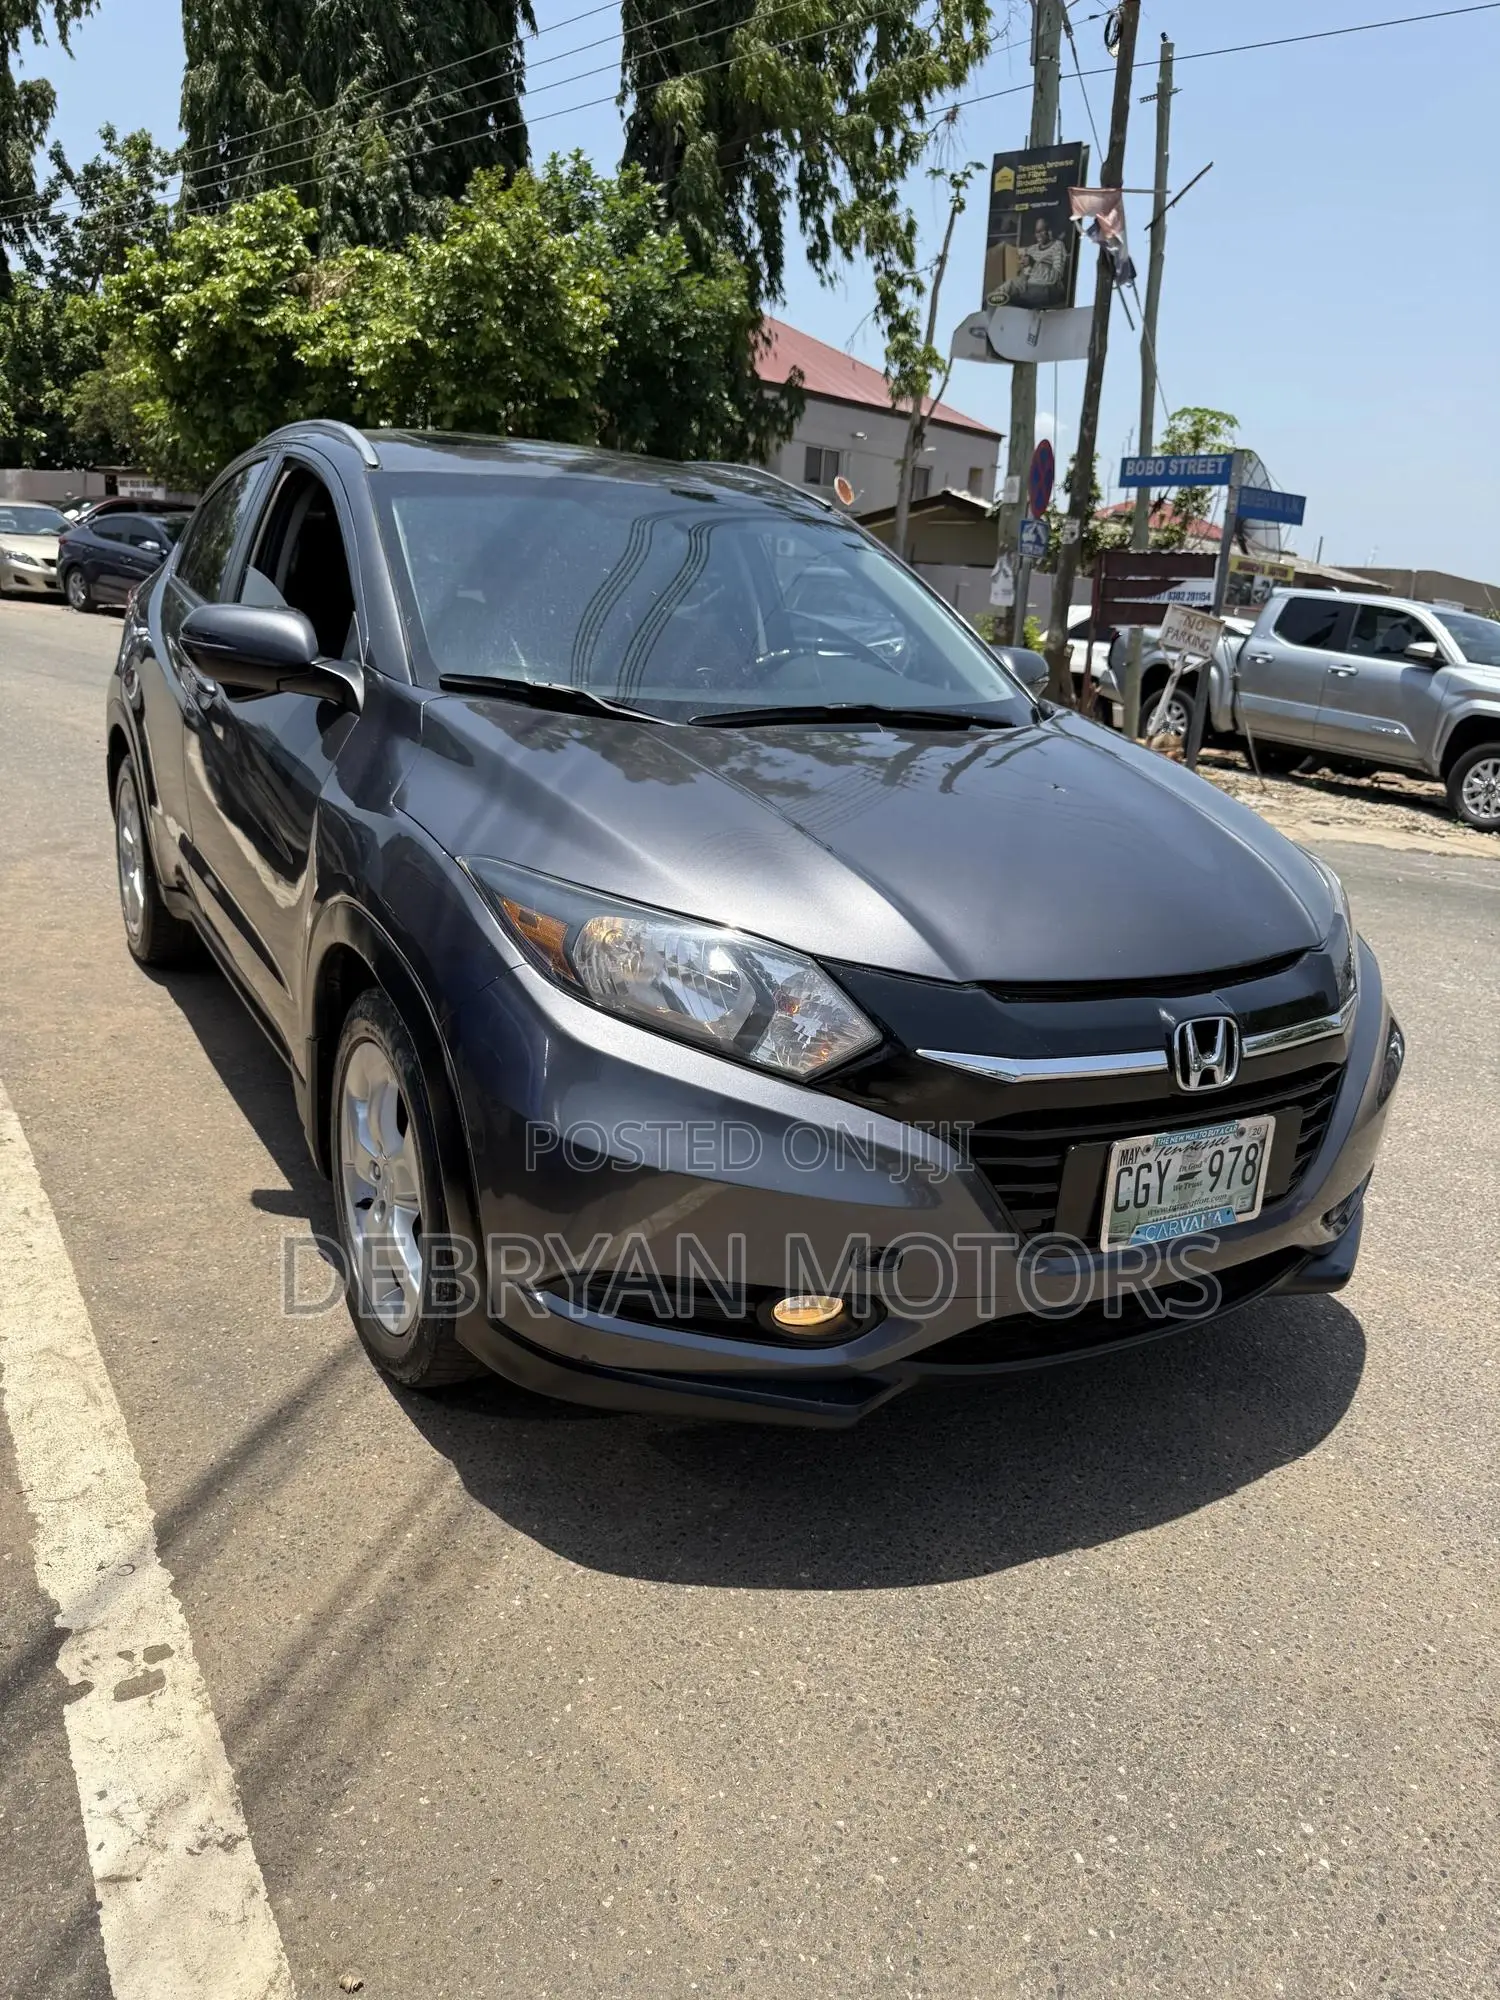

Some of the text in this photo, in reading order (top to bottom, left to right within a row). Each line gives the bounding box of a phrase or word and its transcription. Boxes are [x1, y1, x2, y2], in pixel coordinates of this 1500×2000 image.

[1028, 170, 1047, 178] Fibre
[1126, 457, 1226, 476] BOBO STREET
[1165, 615, 1211, 652] NO PARKING
[1157, 1138, 1169, 1146] THE
[1170, 1135, 1184, 1143] NEW
[1185, 1132, 1198, 1141] WAY
[1208, 1129, 1218, 1137] BUY
[1224, 1126, 1237, 1134] CAR
[1120, 1147, 1140, 1166] MAY
[1155, 1136, 1229, 1161] Tennessee
[1188, 1160, 1203, 1170] God
[1173, 1180, 1203, 1192] We Trust
